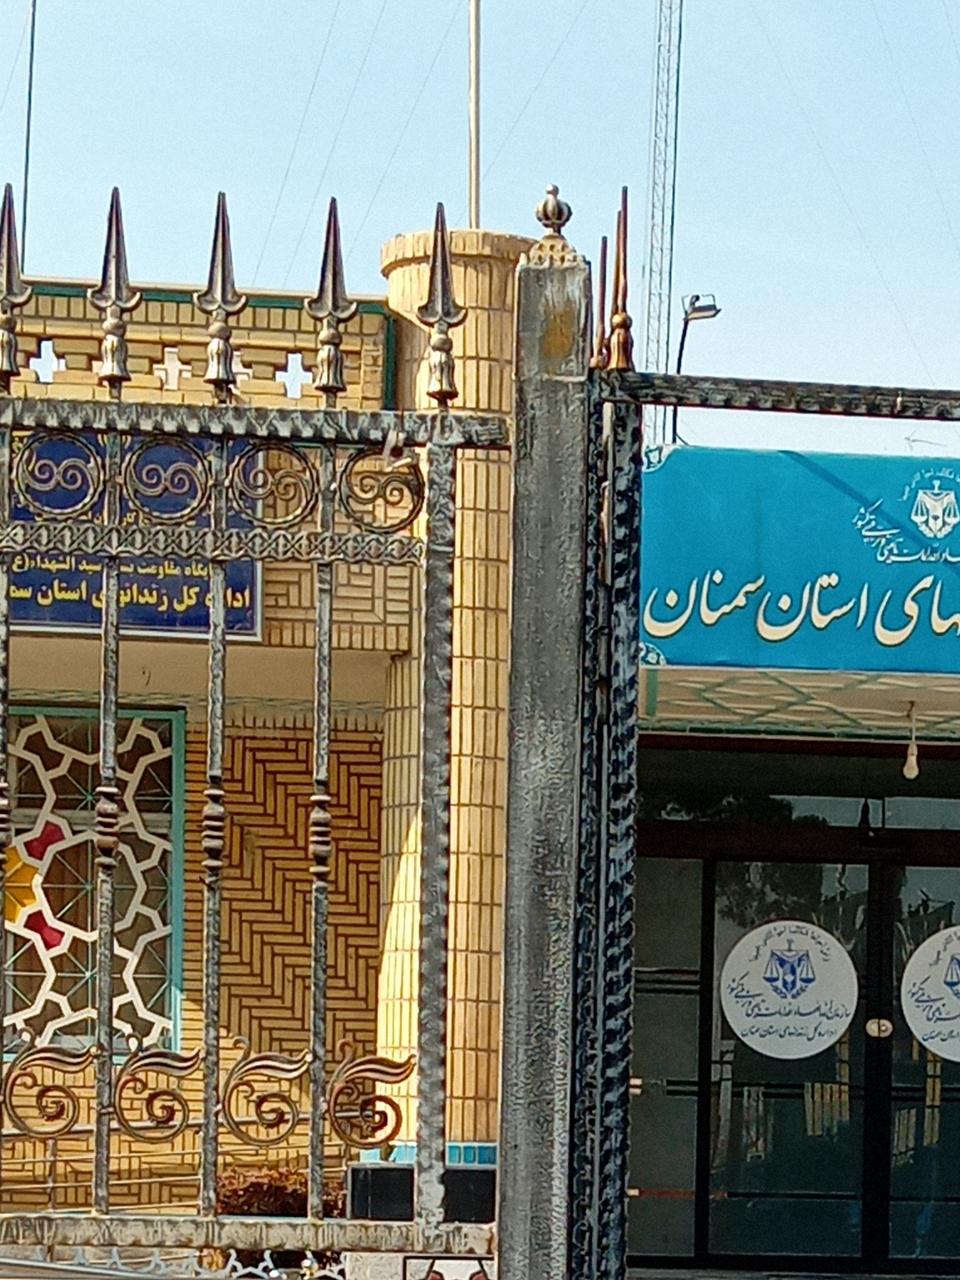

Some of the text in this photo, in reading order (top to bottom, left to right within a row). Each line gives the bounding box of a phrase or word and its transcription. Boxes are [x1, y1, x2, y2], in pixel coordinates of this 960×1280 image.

[36, 578, 88, 607] استان
[172, 585, 200, 613] کل
[203, 584, 251, 608] اداه
[642, 569, 765, 639] سمنان
[754, 574, 866, 644] استان
